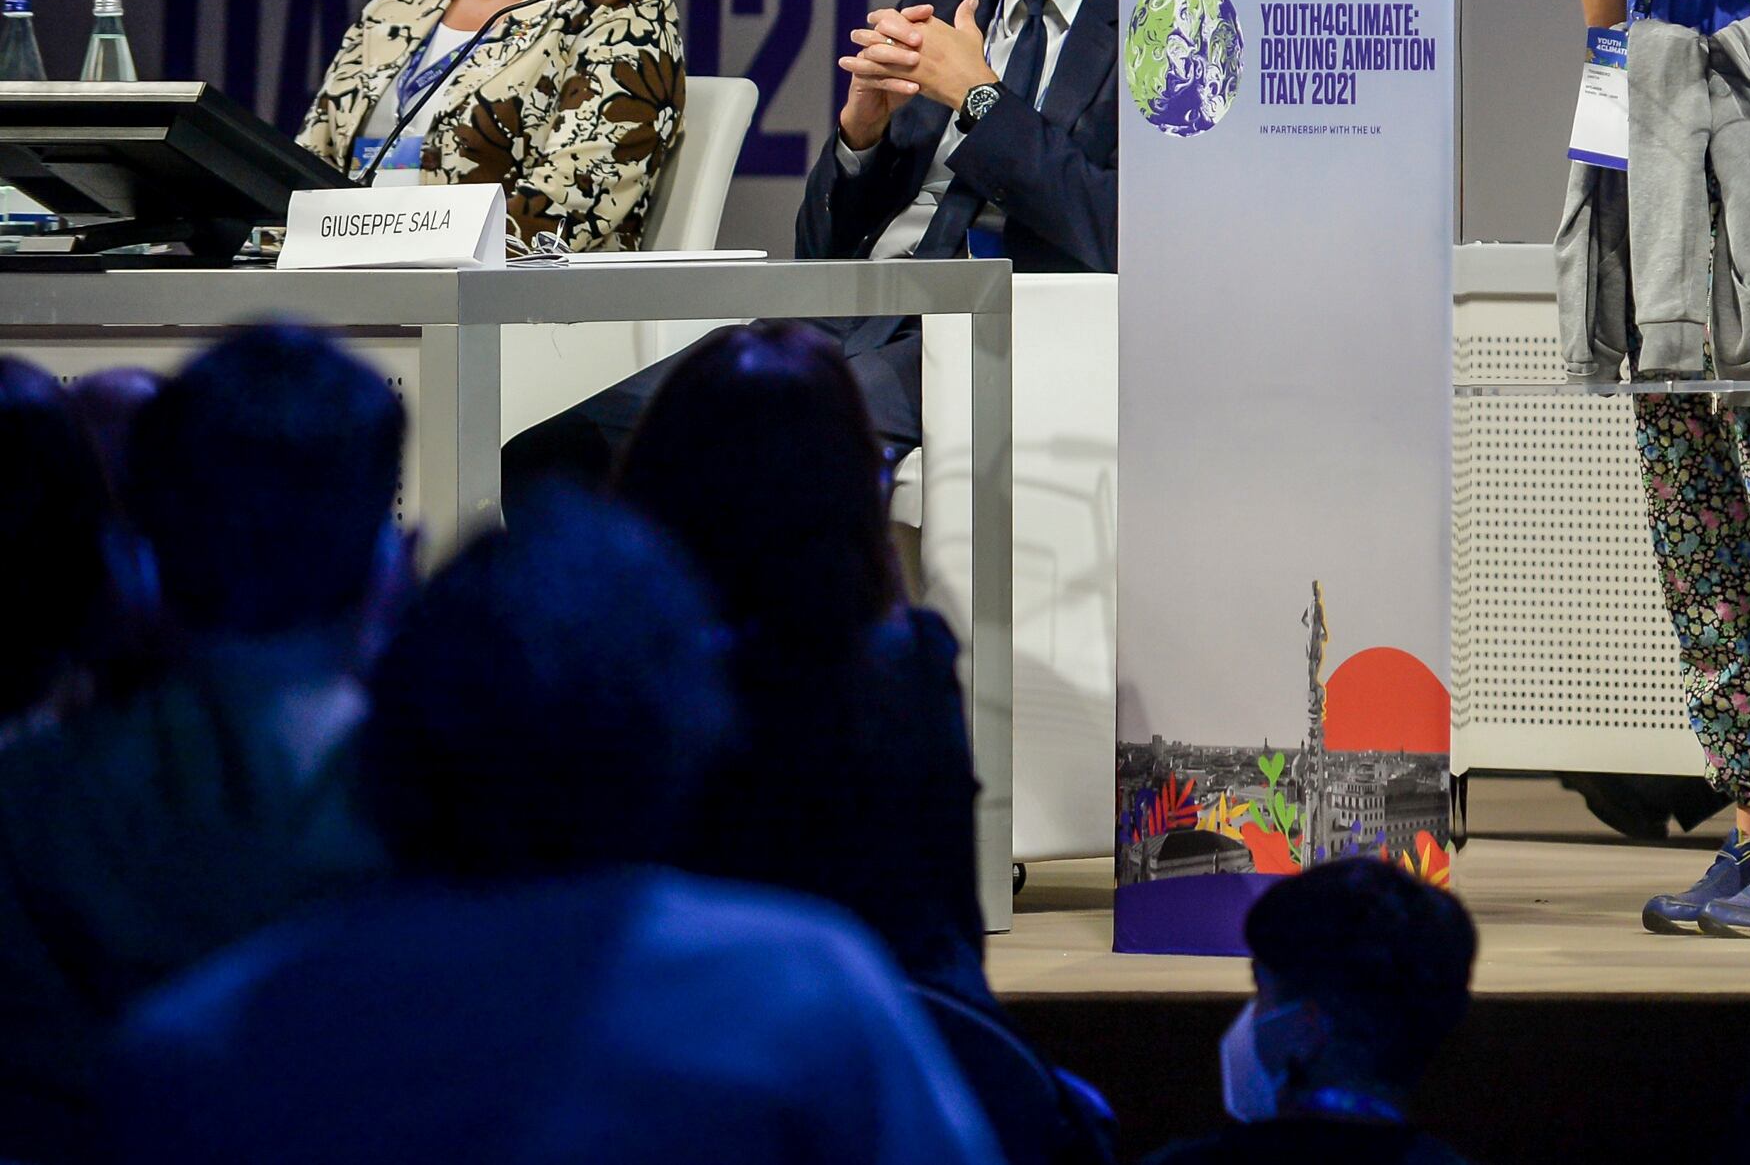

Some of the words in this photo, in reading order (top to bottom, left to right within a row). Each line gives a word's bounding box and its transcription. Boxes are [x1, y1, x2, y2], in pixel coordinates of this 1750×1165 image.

[1260, 3, 1419, 36] YOUTH4CLIMATE:
[1260, 38, 1337, 71] DRIVING
[1341, 38, 1436, 71] AMBITION
[1597, 37, 1622, 47] YOUTH
[1260, 72, 1308, 105] ITALY
[1311, 72, 1356, 105] 2021
[1260, 125, 1269, 134] IN
[1270, 125, 1328, 134] PARTNERSHIP
[1330, 125, 1350, 134] WITH
[1352, 125, 1368, 134] THE
[1370, 125, 1381, 134] UK
[321, 214, 407, 237] GIUSEPPE
[408, 209, 451, 232] SALA
